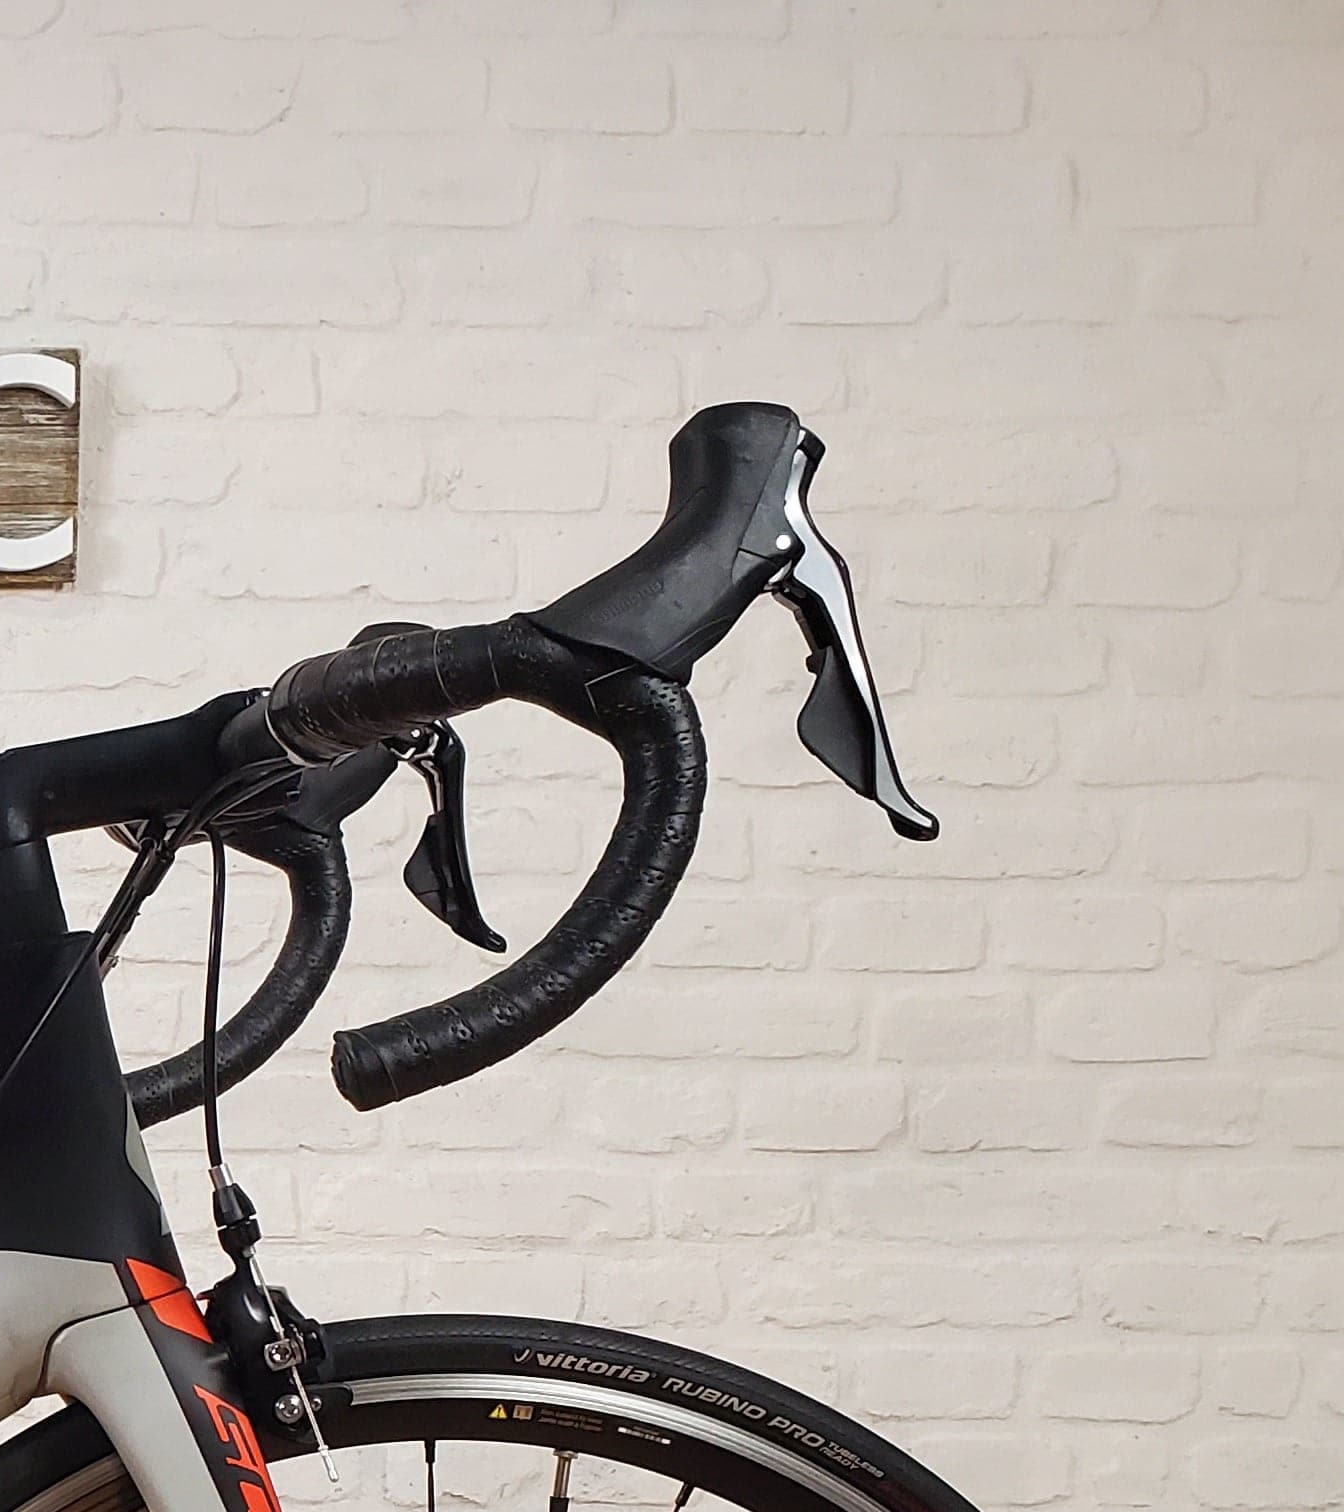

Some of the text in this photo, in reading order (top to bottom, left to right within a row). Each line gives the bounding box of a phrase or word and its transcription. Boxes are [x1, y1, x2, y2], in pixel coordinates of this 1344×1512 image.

[536, 1352, 826, 1449] vittoria RUBINO PRO
